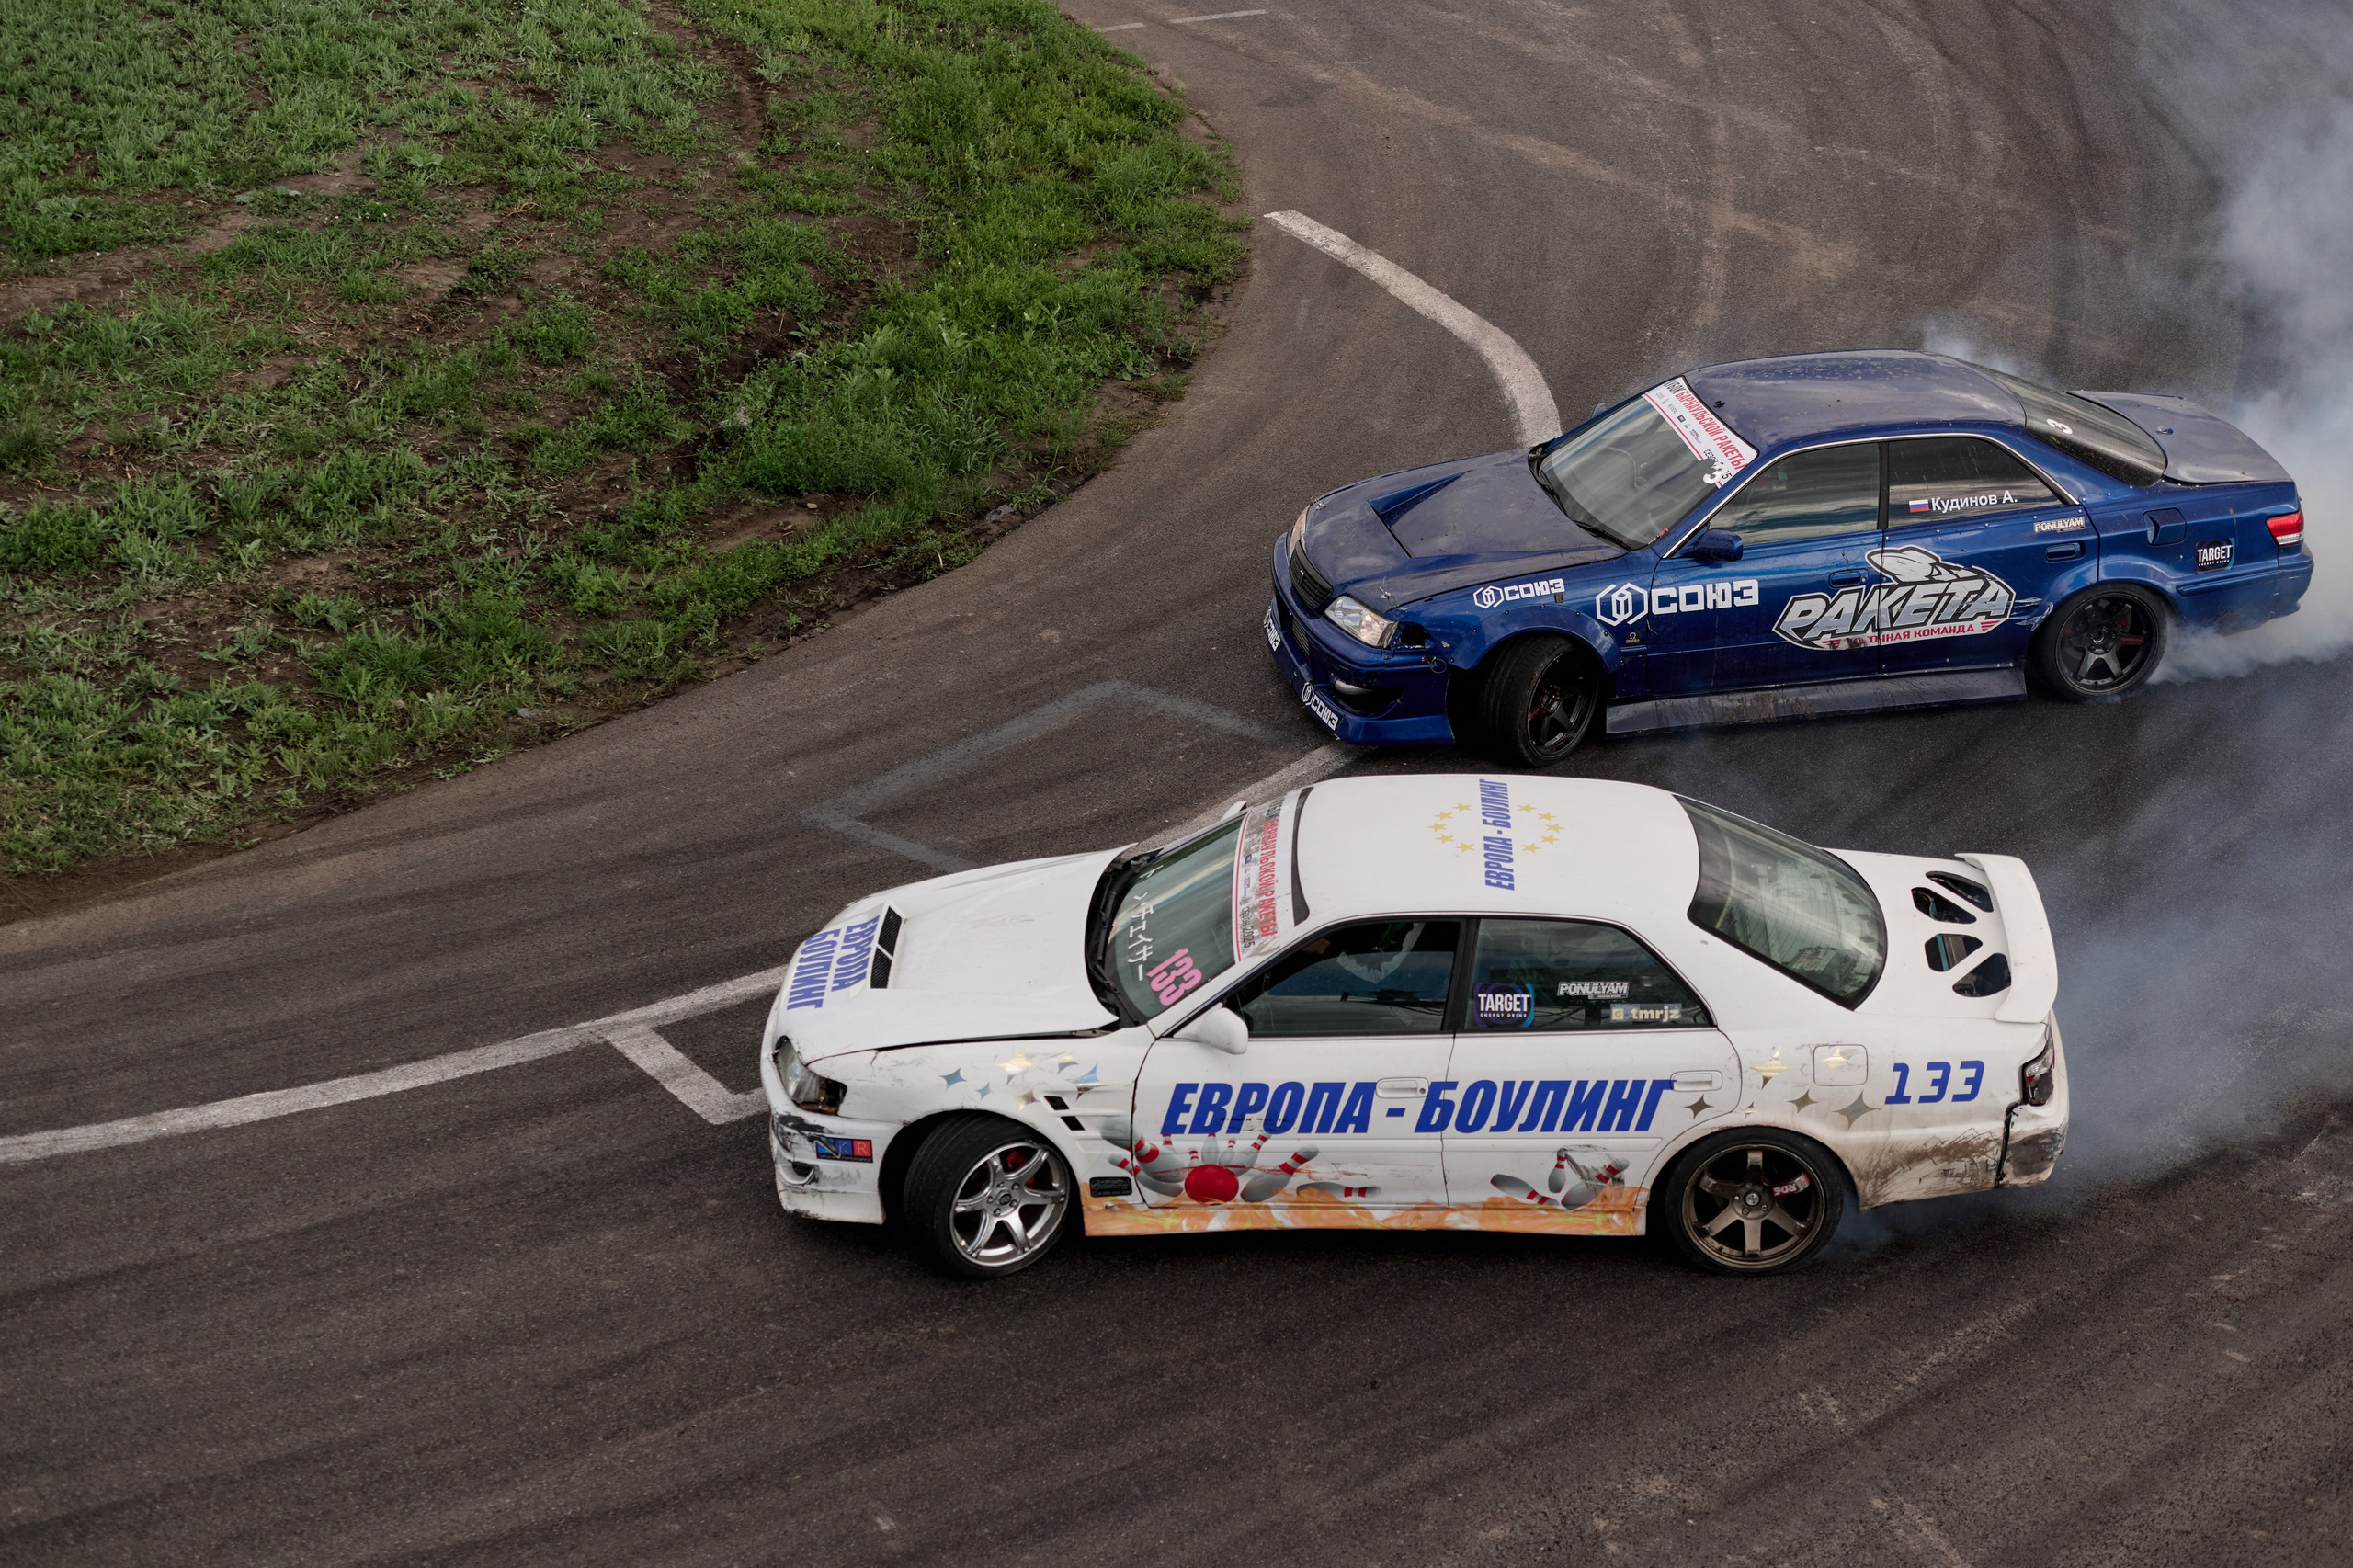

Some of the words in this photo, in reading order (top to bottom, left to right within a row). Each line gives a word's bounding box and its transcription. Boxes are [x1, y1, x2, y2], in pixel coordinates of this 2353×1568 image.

[1675, 391, 1725, 437] БАРНАУЛЬСКОЙ
[1713, 436, 1748, 470] РАКЕТЫ
[2046, 418, 2073, 434] 3
[1702, 464, 1728, 484] 3
[1931, 494, 1998, 513] Кудинов
[2002, 490, 2018, 504] А.
[2034, 517, 2084, 533] PONULYAM
[2197, 544, 2233, 562] TARGET
[1504, 578, 1565, 601] СОЮЗ
[1652, 579, 1759, 615] СОЮЗ
[1778, 577, 2011, 642] РАКЕТА
[1914, 624, 1974, 638] КОМАНДА
[1311, 694, 1339, 732] СОЮЗ
[1479, 778, 1511, 829] БОУЛИНГ
[1258, 818, 1279, 888] БАРНАУЛЬСКОЙ
[1483, 836, 1515, 891] ЕВРОПА
[1258, 889, 1278, 937] РАКЕТЫ
[831, 915, 880, 992] ЕВРОПА
[1242, 926, 1256, 949] 2025
[787, 928, 841, 1010] БОУЛИНГ
[1146, 948, 1202, 1006] 133
[1478, 994, 1531, 1012] TARGET
[1559, 982, 1629, 995] PONULYAM
[1631, 1006, 1681, 1023] tmrjz
[1884, 1060, 1985, 1105] 133
[1160, 1081, 1376, 1135] ЕВРОПА
[1414, 1079, 1677, 1134] БОУЛИНГ
